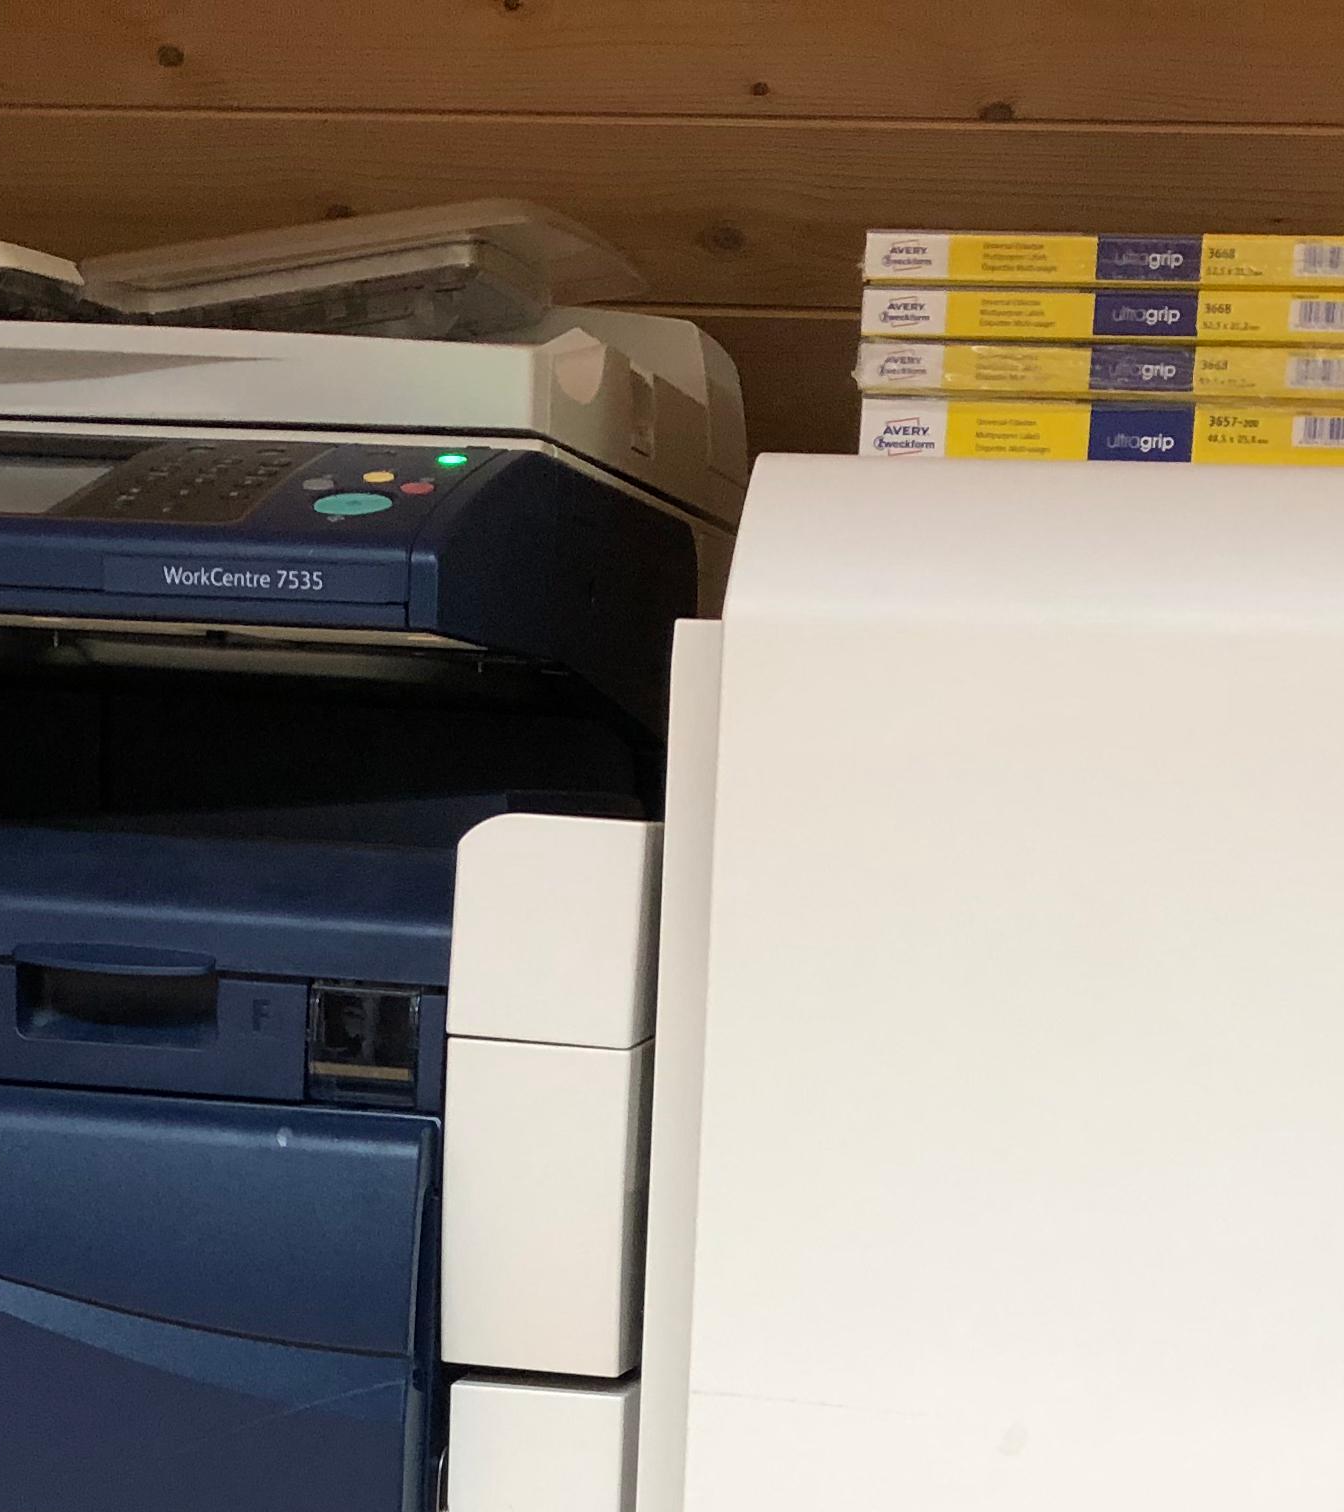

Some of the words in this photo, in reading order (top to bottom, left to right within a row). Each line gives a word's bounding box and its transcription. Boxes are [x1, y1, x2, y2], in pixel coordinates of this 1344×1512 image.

[889, 246, 927, 255] AVERY
[887, 302, 925, 311] AVERY
[1112, 306, 1181, 325] ultragrip
[883, 426, 930, 436] AVERY
[1107, 433, 1174, 452] ultragrip
[163, 565, 271, 588] WorkCentre
[276, 570, 323, 590] 7535
